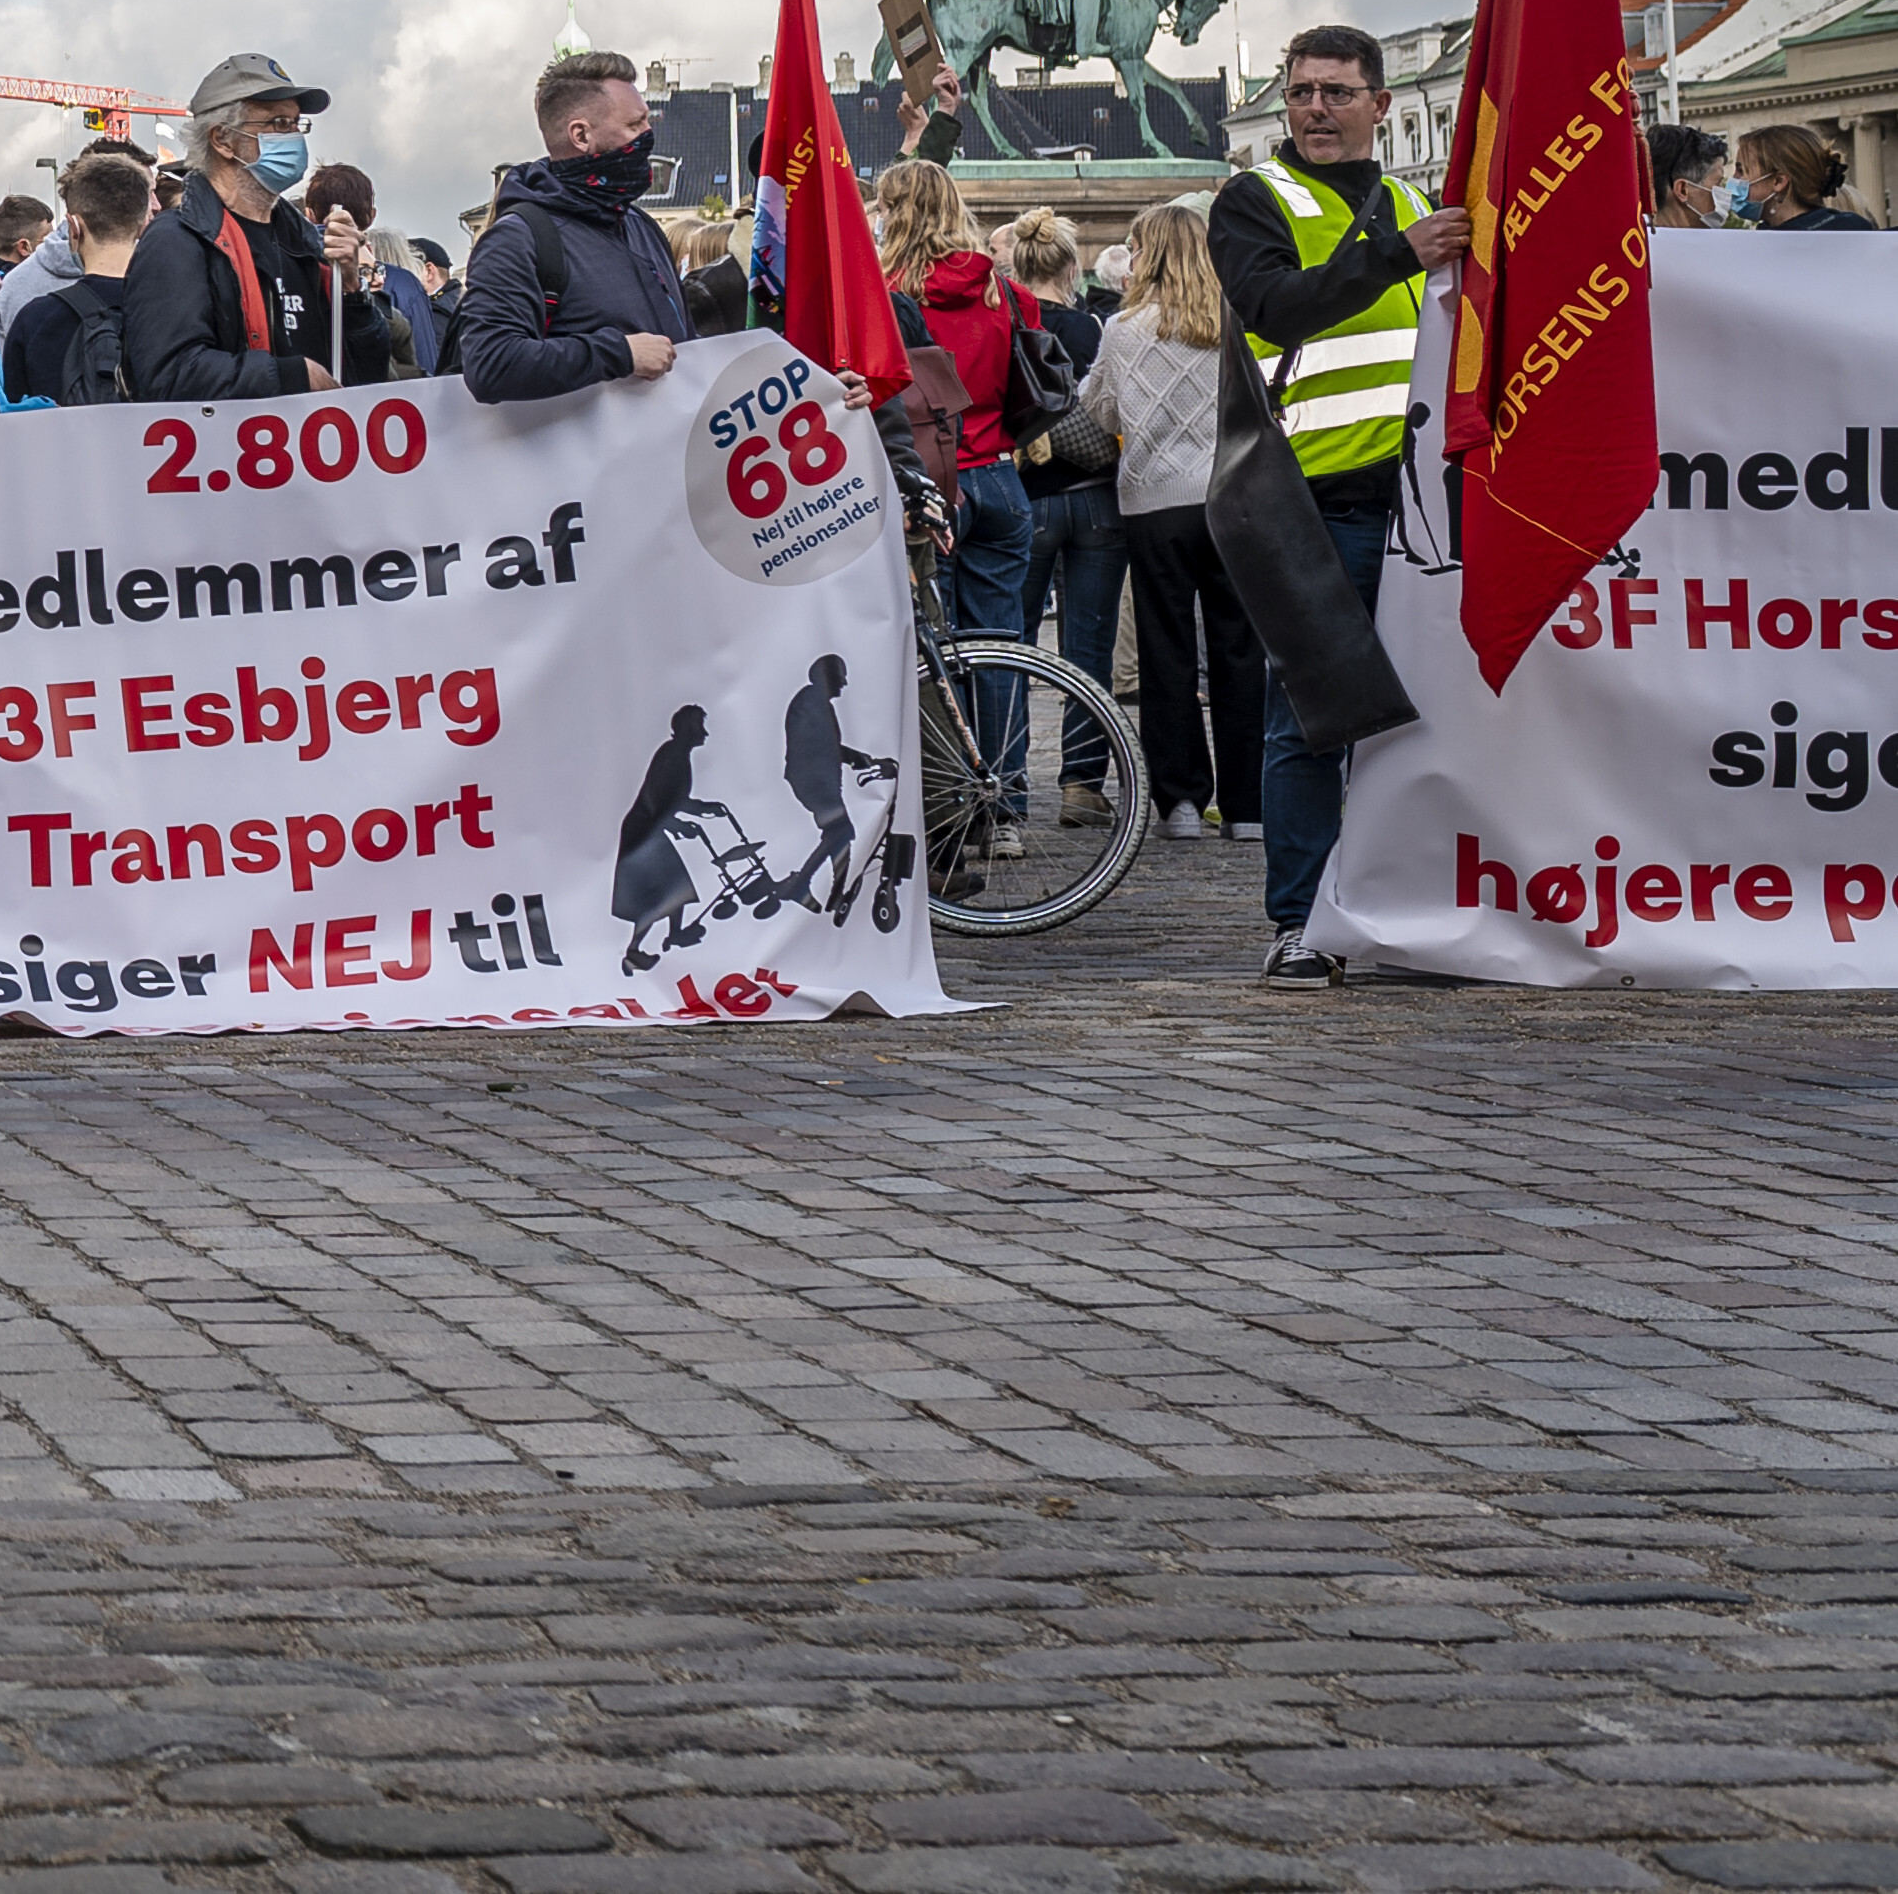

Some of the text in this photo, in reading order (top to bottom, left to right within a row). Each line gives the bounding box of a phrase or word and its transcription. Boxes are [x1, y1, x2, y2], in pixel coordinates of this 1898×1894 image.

[144, 399, 426, 493] 2.800
[708, 358, 811, 450] STOP
[726, 400, 848, 520] 68
[485, 501, 585, 590] af
[752, 476, 865, 549] Nej til højere
[760, 496, 882, 578] pensionsalder
[1550, 579, 1659, 650] 3F
[121, 657, 500, 761] Esbjerg
[8, 785, 495, 892] Transport
[1457, 833, 1792, 948] højere
[249, 910, 431, 993] NEJ
[448, 893, 563, 972] til
